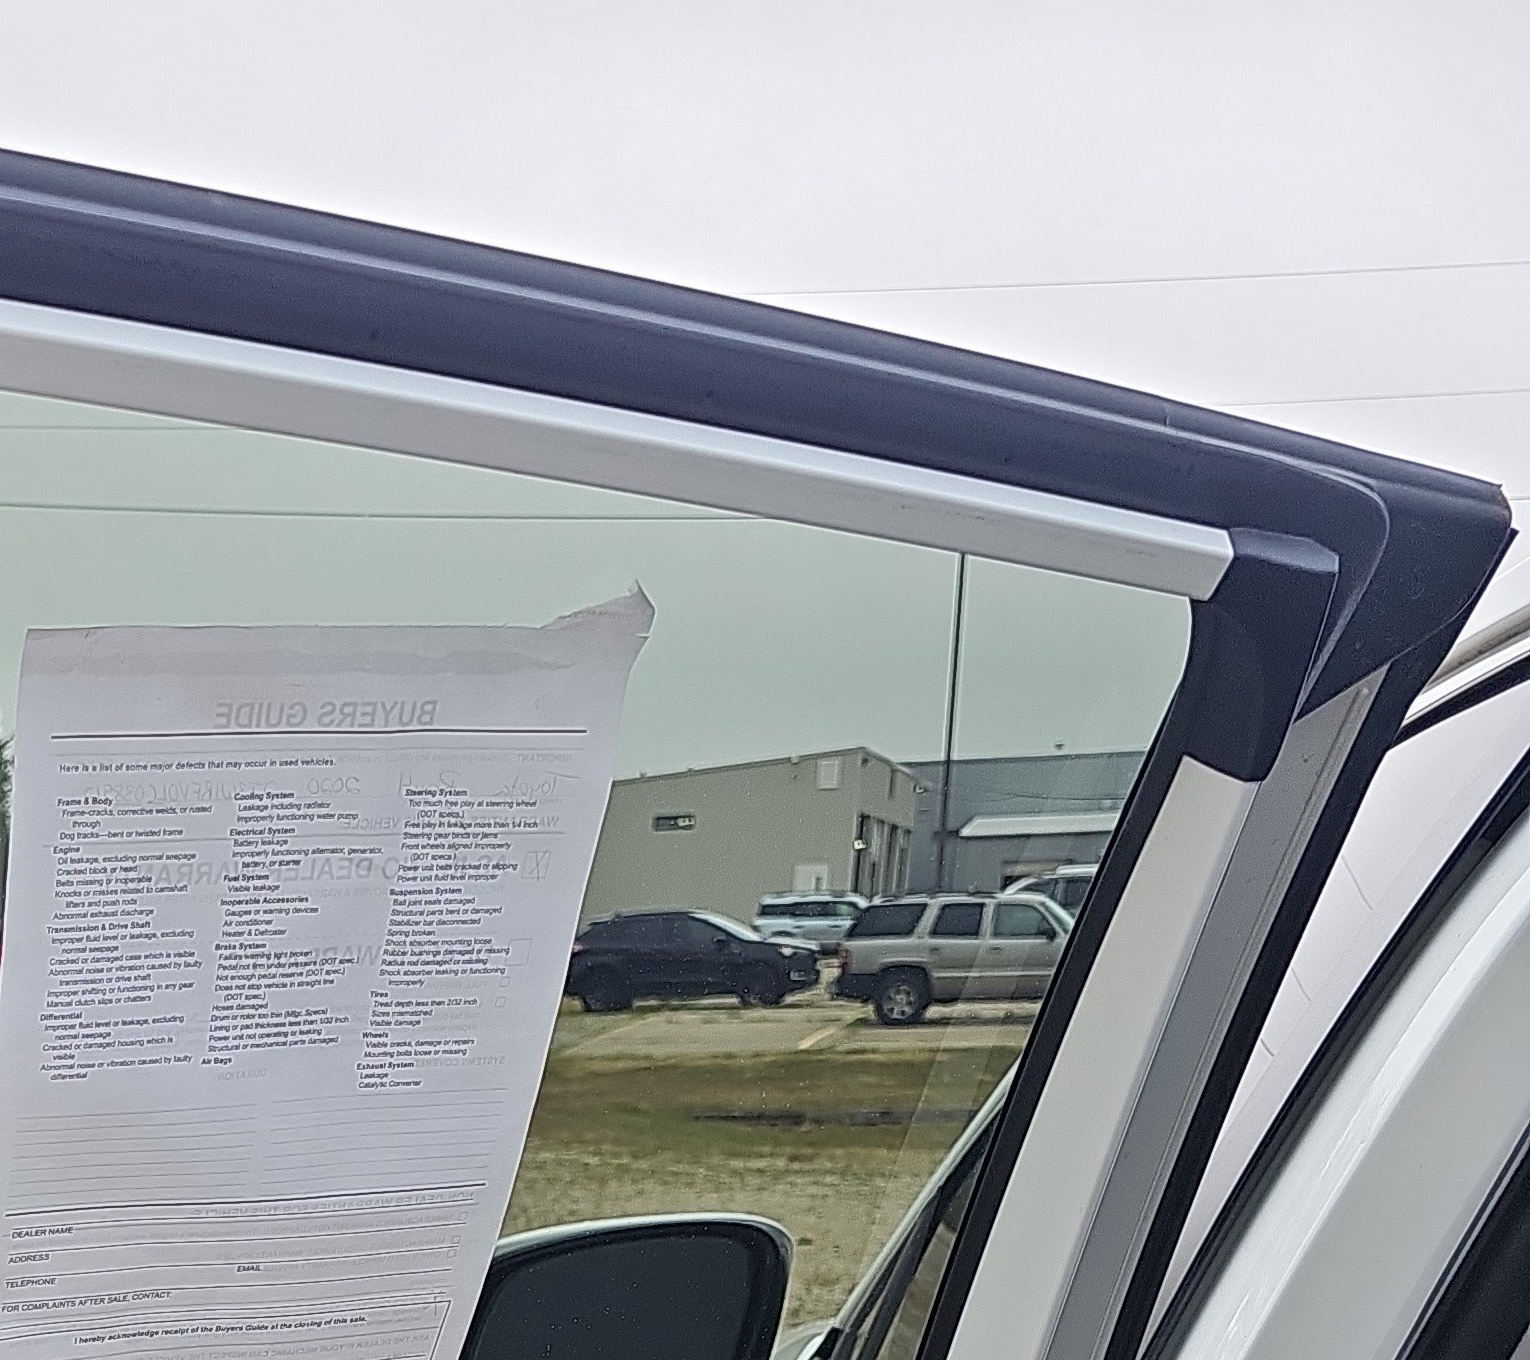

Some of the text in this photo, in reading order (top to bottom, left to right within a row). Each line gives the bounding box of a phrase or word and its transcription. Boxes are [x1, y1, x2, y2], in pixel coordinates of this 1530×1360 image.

[59, 764, 79, 772] Here
[82, 764, 89, 772] is
[99, 763, 112, 771] list
[115, 763, 124, 771] of
[150, 763, 173, 772] major
[175, 761, 206, 770] defects
[208, 761, 224, 769] that
[225, 762, 242, 770] may
[270, 760, 276, 768] in
[279, 760, 299, 768] used
[234, 792, 295, 801] Cooling System
[404, 789, 468, 798] Steering System
[57, 797, 113, 807] Frame & Body
[238, 802, 331, 812] Leakage including radiator
[236, 814, 275, 824] Improperly
[276, 813, 315, 822] functioning
[72, 820, 101, 829] through
[230, 827, 296, 837] Electrical System
[233, 839, 289, 848] Battery leakage
[53, 846, 81, 855] Engine
[223, 874, 270, 883] Fuel System
[228, 884, 281, 893] Visible leakage
[389, 888, 463, 897] Suspension System
[220, 896, 309, 908] Inoperable Accessories
[53, 908, 155, 920] Abnormal exhaust discharge
[46, 921, 151, 934] Transmission & Drive Shaft
[234, 919, 274, 927] conditioner
[387, 929, 410, 938] Spring
[61, 946, 119, 954] normal seepage
[215, 942, 267, 951] Brake System
[40, 1012, 83, 1021] Differential
[362, 1031, 389, 1039] Wheels
[213, 1057, 233, 1066] Bags
[387, 1062, 415, 1071] System
[360, 1072, 389, 1080] Leakage
[358, 1080, 423, 1090] Catalytic Converter
[11, 1227, 74, 1239] DEALER NAME
[8, 1253, 50, 1264] ADDRESS
[5, 1277, 58, 1289] TELEPHONE
[1, 1304, 20, 1313] FOR
[21, 1300, 76, 1312] COMPLAINTS
[78, 1297, 106, 1308] AFTER
[107, 1295, 130, 1305] SALE,
[79, 1334, 106, 1344] hereby
[107, 1329, 160, 1341] acknowledge
[161, 1327, 189, 1336] receipt
[215, 1325, 244, 1333] Buyers
[245, 1323, 269, 1331] Guide
[294, 1319, 322, 1328] closing
[333, 1317, 348, 1325] this
